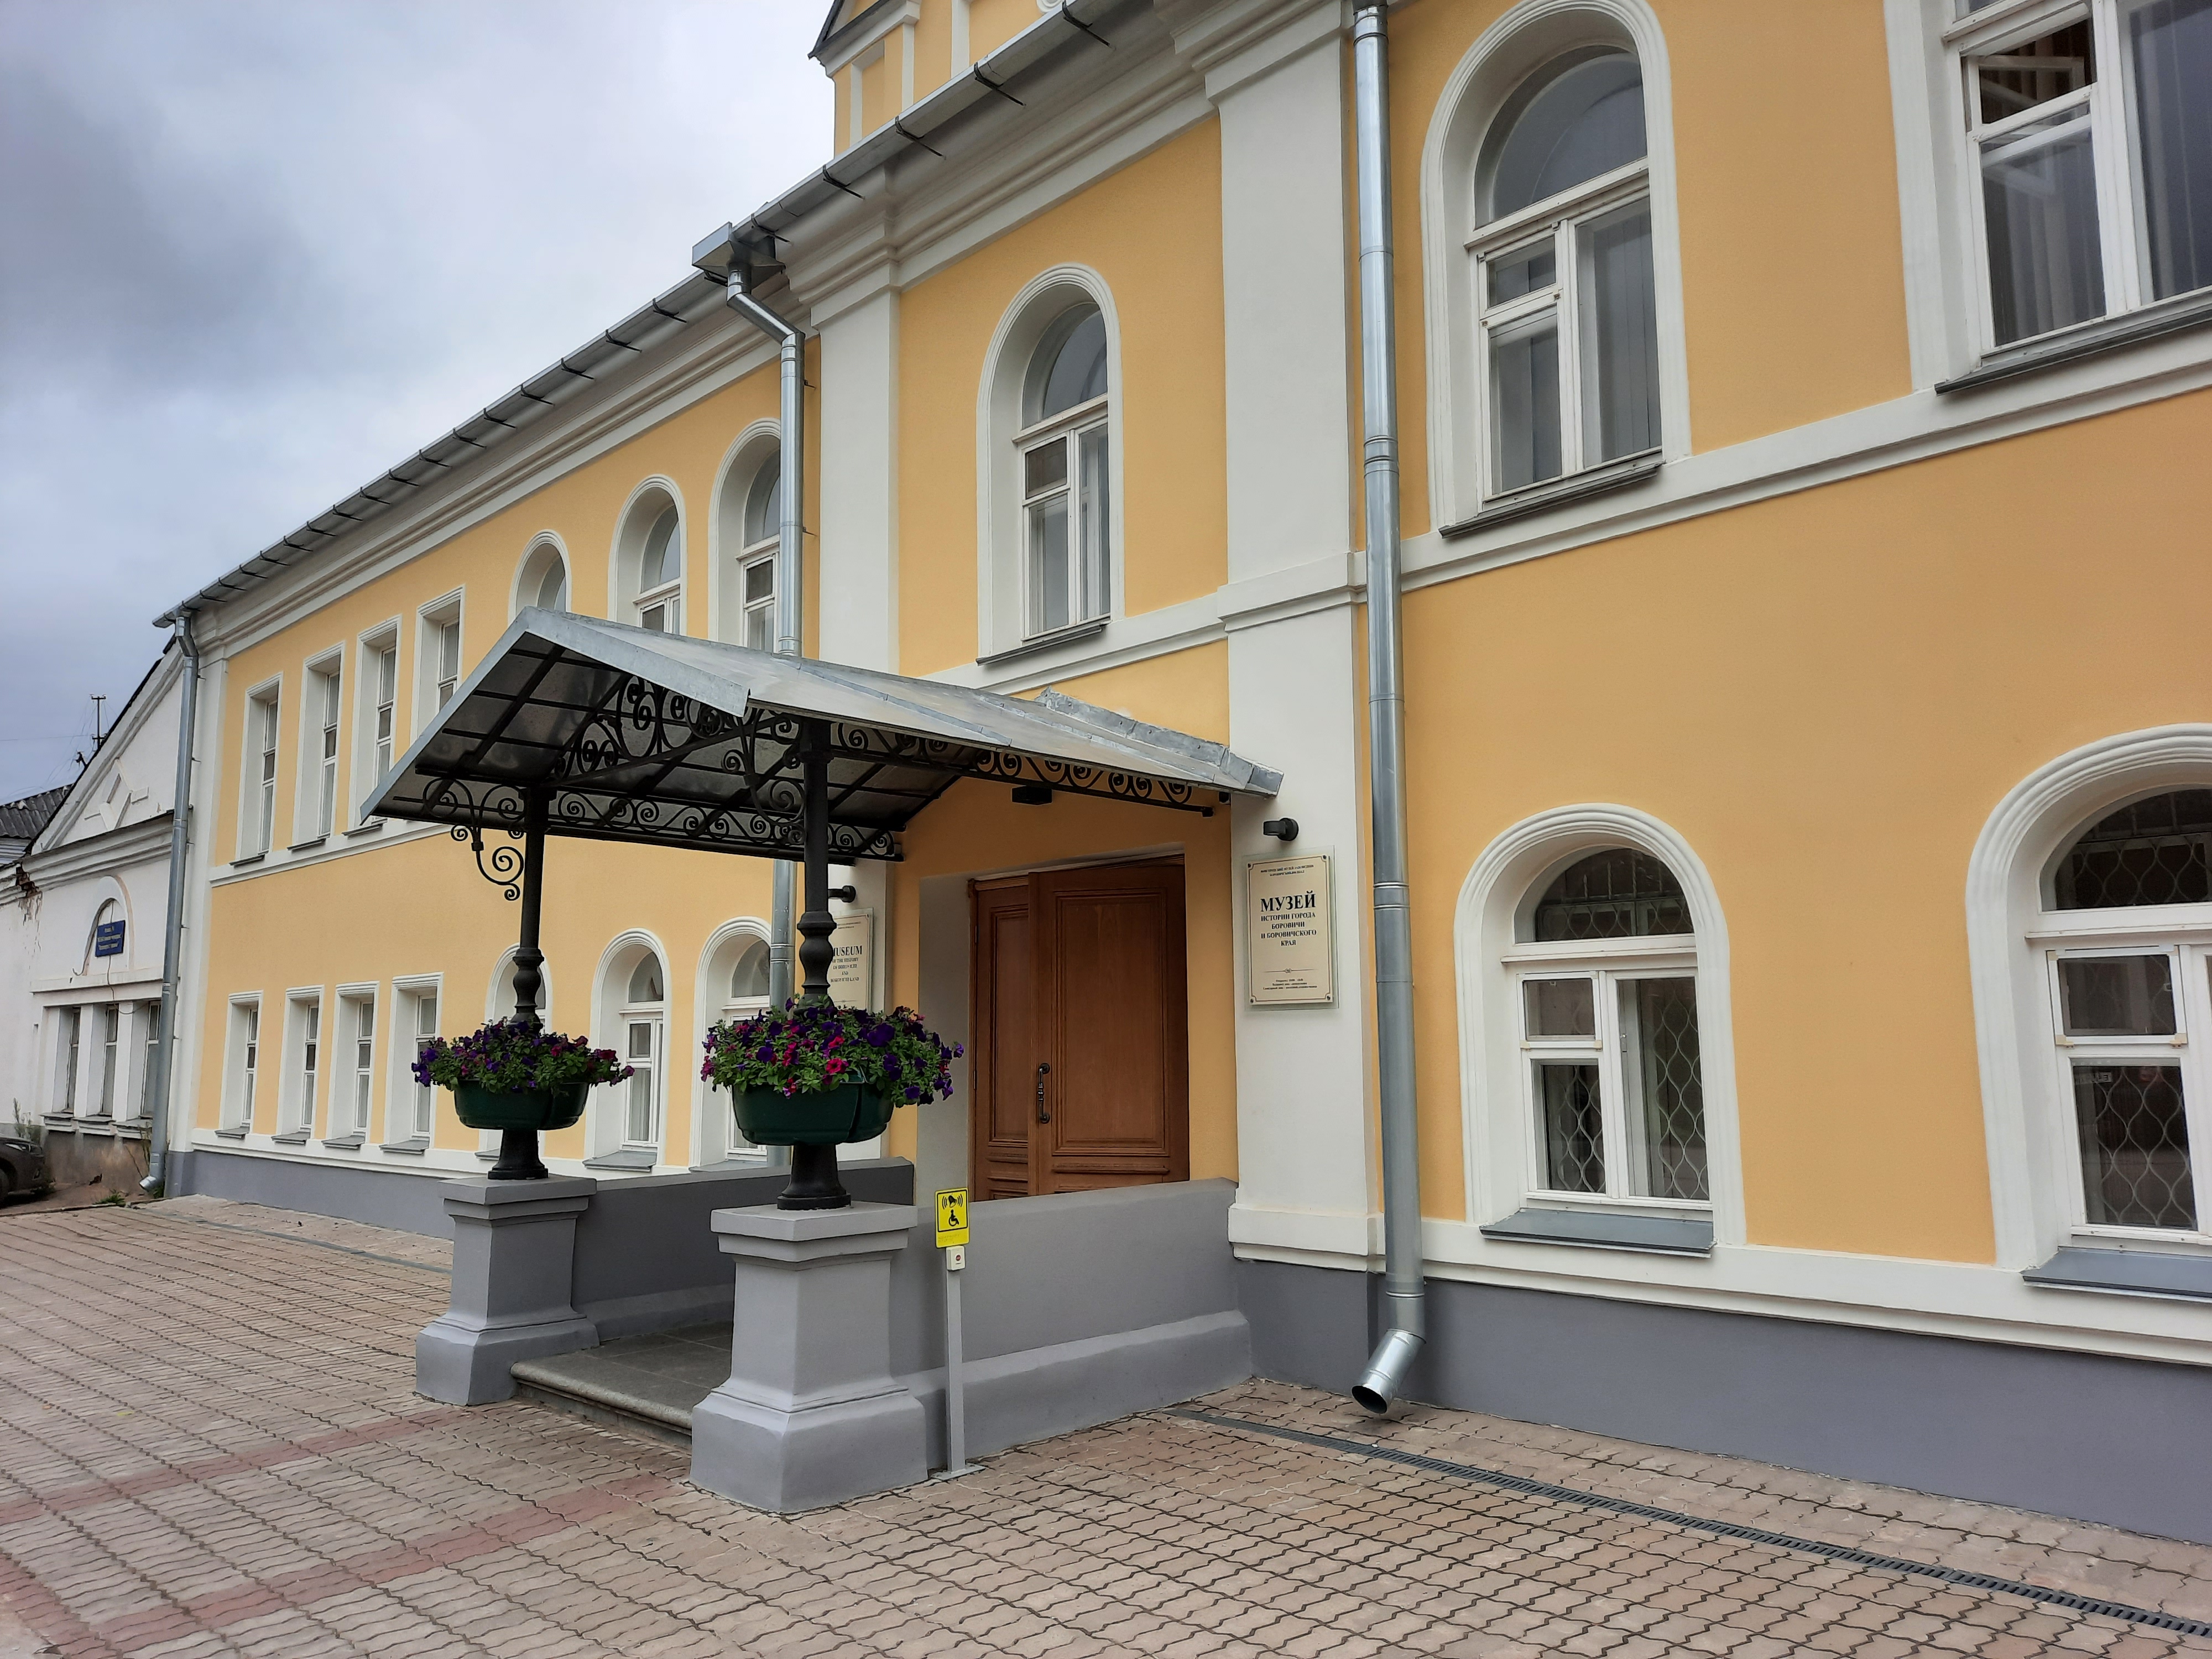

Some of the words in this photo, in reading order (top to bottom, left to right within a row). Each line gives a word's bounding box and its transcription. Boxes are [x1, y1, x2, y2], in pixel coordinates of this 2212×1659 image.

[1260, 890, 1316, 912] МУЗЕЙ
[1261, 914, 1290, 922] ИСТОРИИ
[1271, 921, 1305, 930] БОРОВИЧИ
[1267, 930, 1317, 938] БОРОВИЧСКОГО
